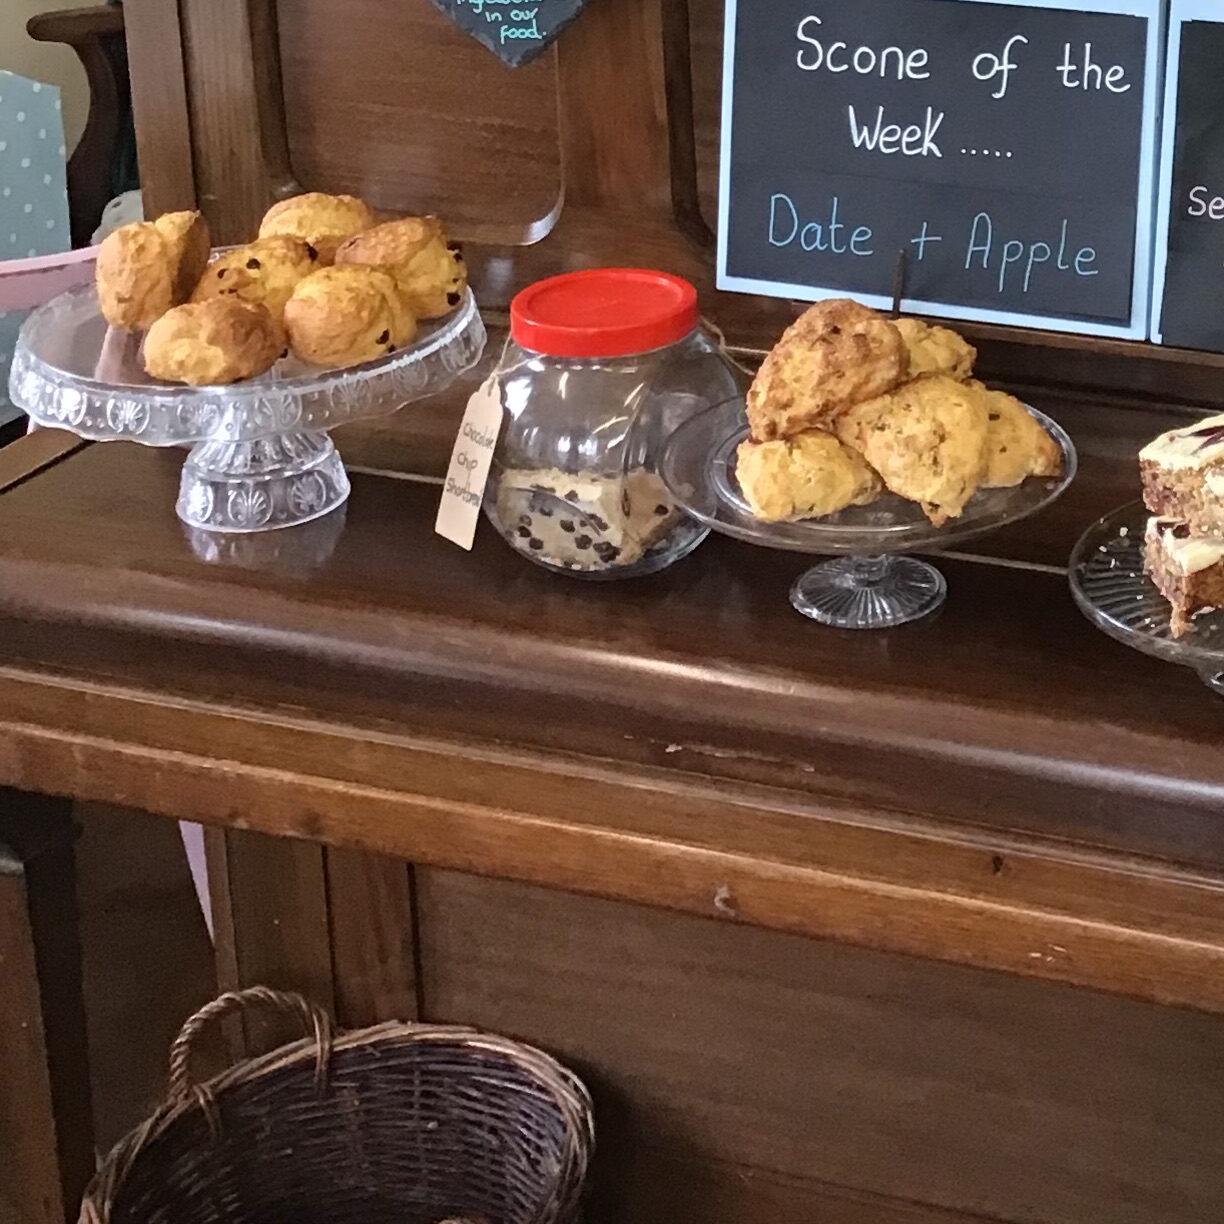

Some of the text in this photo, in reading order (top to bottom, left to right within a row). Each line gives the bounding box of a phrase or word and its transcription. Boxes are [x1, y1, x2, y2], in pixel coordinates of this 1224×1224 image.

[510, 8, 538, 22] our
[796, 15, 1132, 99] Scone of the
[768, 192, 1100, 292] Date + Apple
